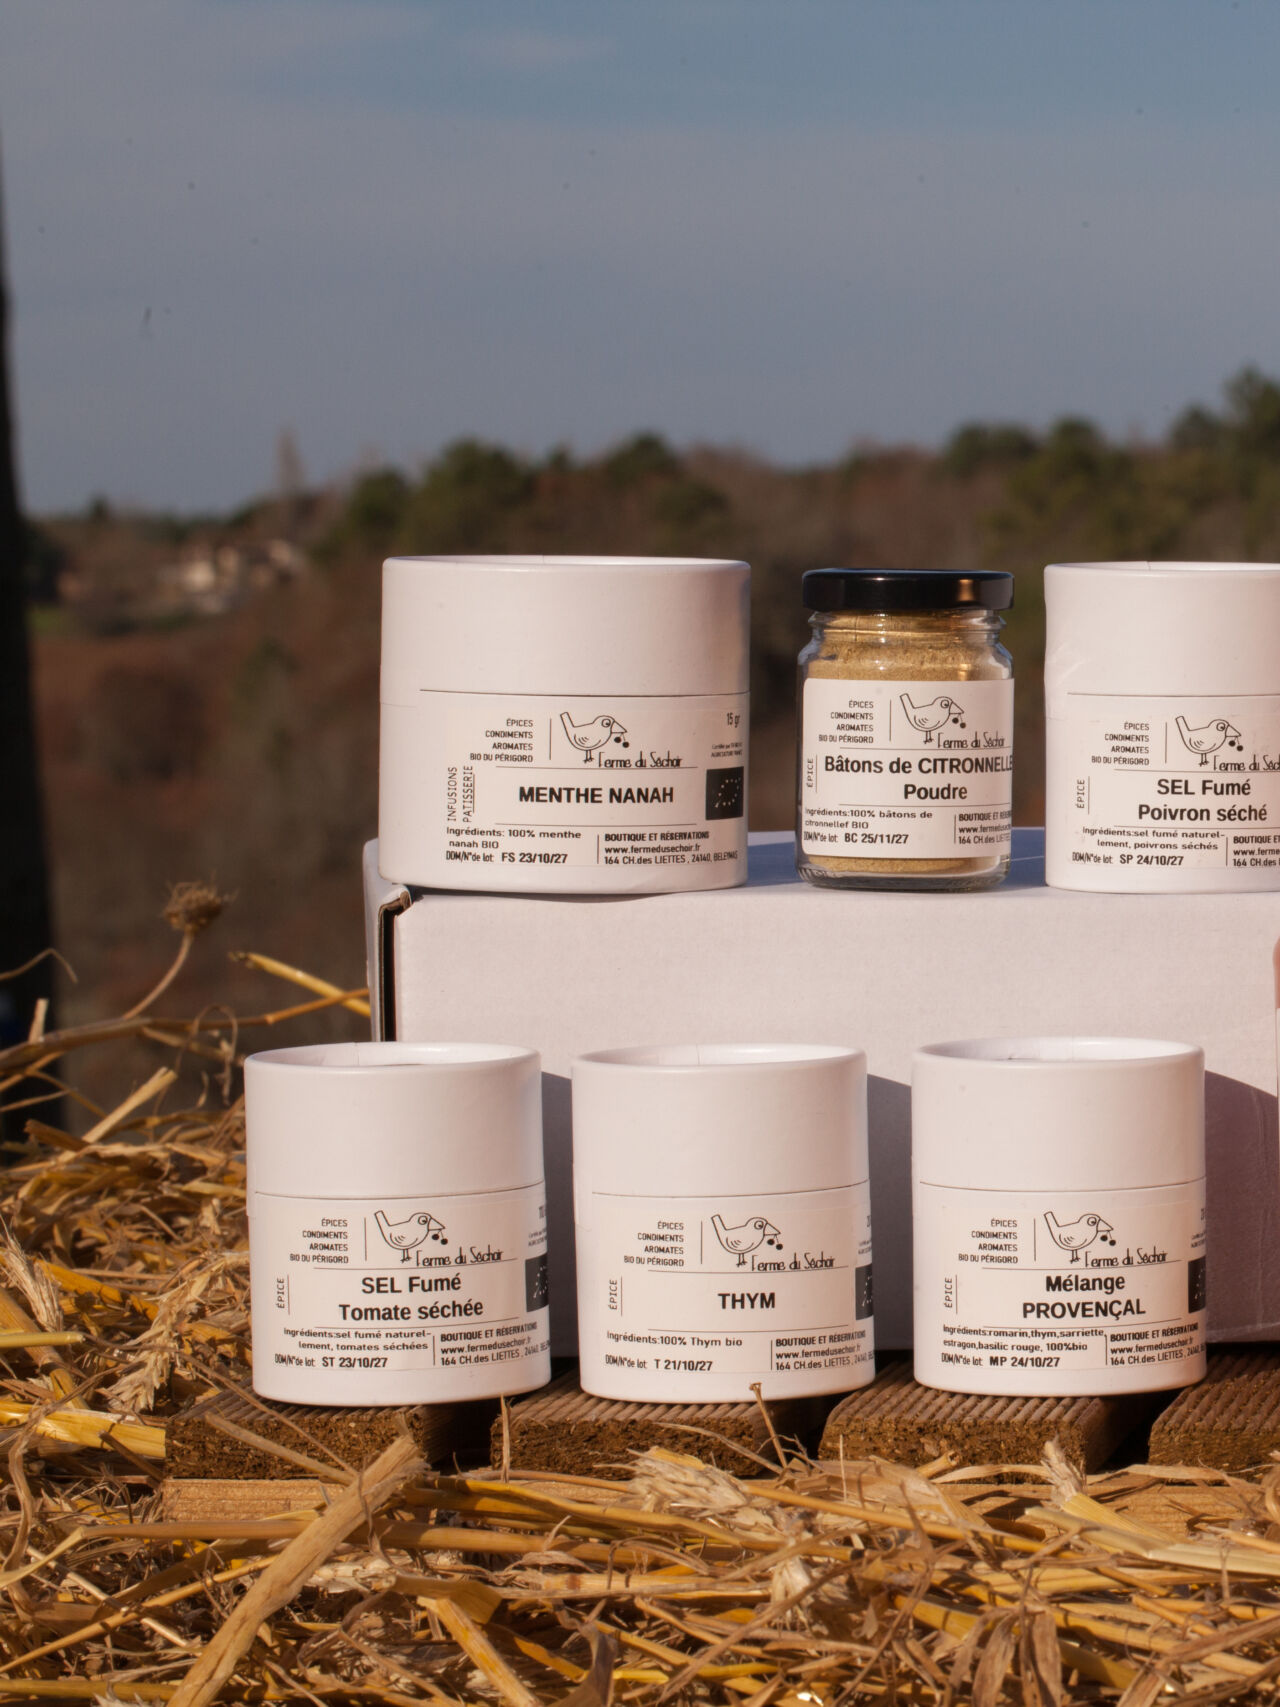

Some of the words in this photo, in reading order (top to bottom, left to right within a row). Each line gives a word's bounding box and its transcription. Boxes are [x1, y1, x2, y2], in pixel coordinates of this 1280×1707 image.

[825, 755, 883, 773] Bâtons
[889, 757, 912, 773] de
[806, 759, 814, 788] ÉPICE
[447, 766, 457, 822] INFUSIONS
[463, 765, 473, 823] PATISSERIE
[519, 786, 603, 803] MENTHE
[609, 786, 674, 803] NANAH
[904, 783, 967, 800] Poudre
[1076, 779, 1085, 809] ÉPICE
[1157, 779, 1195, 796] SEL
[1201, 778, 1251, 796] Fumé
[879, 810, 916, 819] bâtons
[1138, 803, 1211, 821] Poivron
[1217, 803, 1267, 821] séché
[446, 827, 505, 838] Ingrédients:
[508, 828, 536, 839] 100%
[539, 830, 582, 839] menthe
[852, 821, 869, 829] BIO
[844, 832, 858, 844] BC
[861, 833, 909, 844] 25/11/27
[1152, 830, 1178, 838] fumé
[449, 840, 479, 848] nanah
[481, 840, 499, 849] BIO
[1097, 840, 1131, 850] lement,
[1134, 842, 1178, 851] poivrons
[1182, 842, 1218, 850] séchés
[501, 852, 515, 863] FS
[519, 852, 568, 864] 23/10/27
[1119, 854, 1134, 865] SP
[1137, 855, 1184, 866] 24/10/27
[362, 1276, 402, 1294] SEL
[408, 1273, 461, 1293] Fumé
[1045, 1274, 1125, 1295] Mélange
[276, 1278, 285, 1309] ÉPICE
[609, 1279, 618, 1310] ÉPICE
[718, 1292, 776, 1309] THYM
[944, 1277, 953, 1308] ÉPICE
[339, 1303, 411, 1321] Tomate
[418, 1299, 483, 1319] séchée
[1022, 1299, 1146, 1321] PROVENÇAL
[354, 1329, 382, 1339] fumé
[691, 1336, 721, 1347] Thym
[725, 1337, 743, 1346] bio
[299, 1341, 334, 1351] lement,
[336, 1342, 380, 1351] tomates
[384, 1340, 428, 1350] séchées
[1011, 1342, 1042, 1352] rouge,
[322, 1356, 335, 1368] ST
[339, 1356, 388, 1368] 23/10/27
[655, 1359, 661, 1369] T
[664, 1359, 713, 1371] 21/10/27
[989, 1356, 1007, 1367] MP
[1011, 1356, 1060, 1368] 24/10/27
